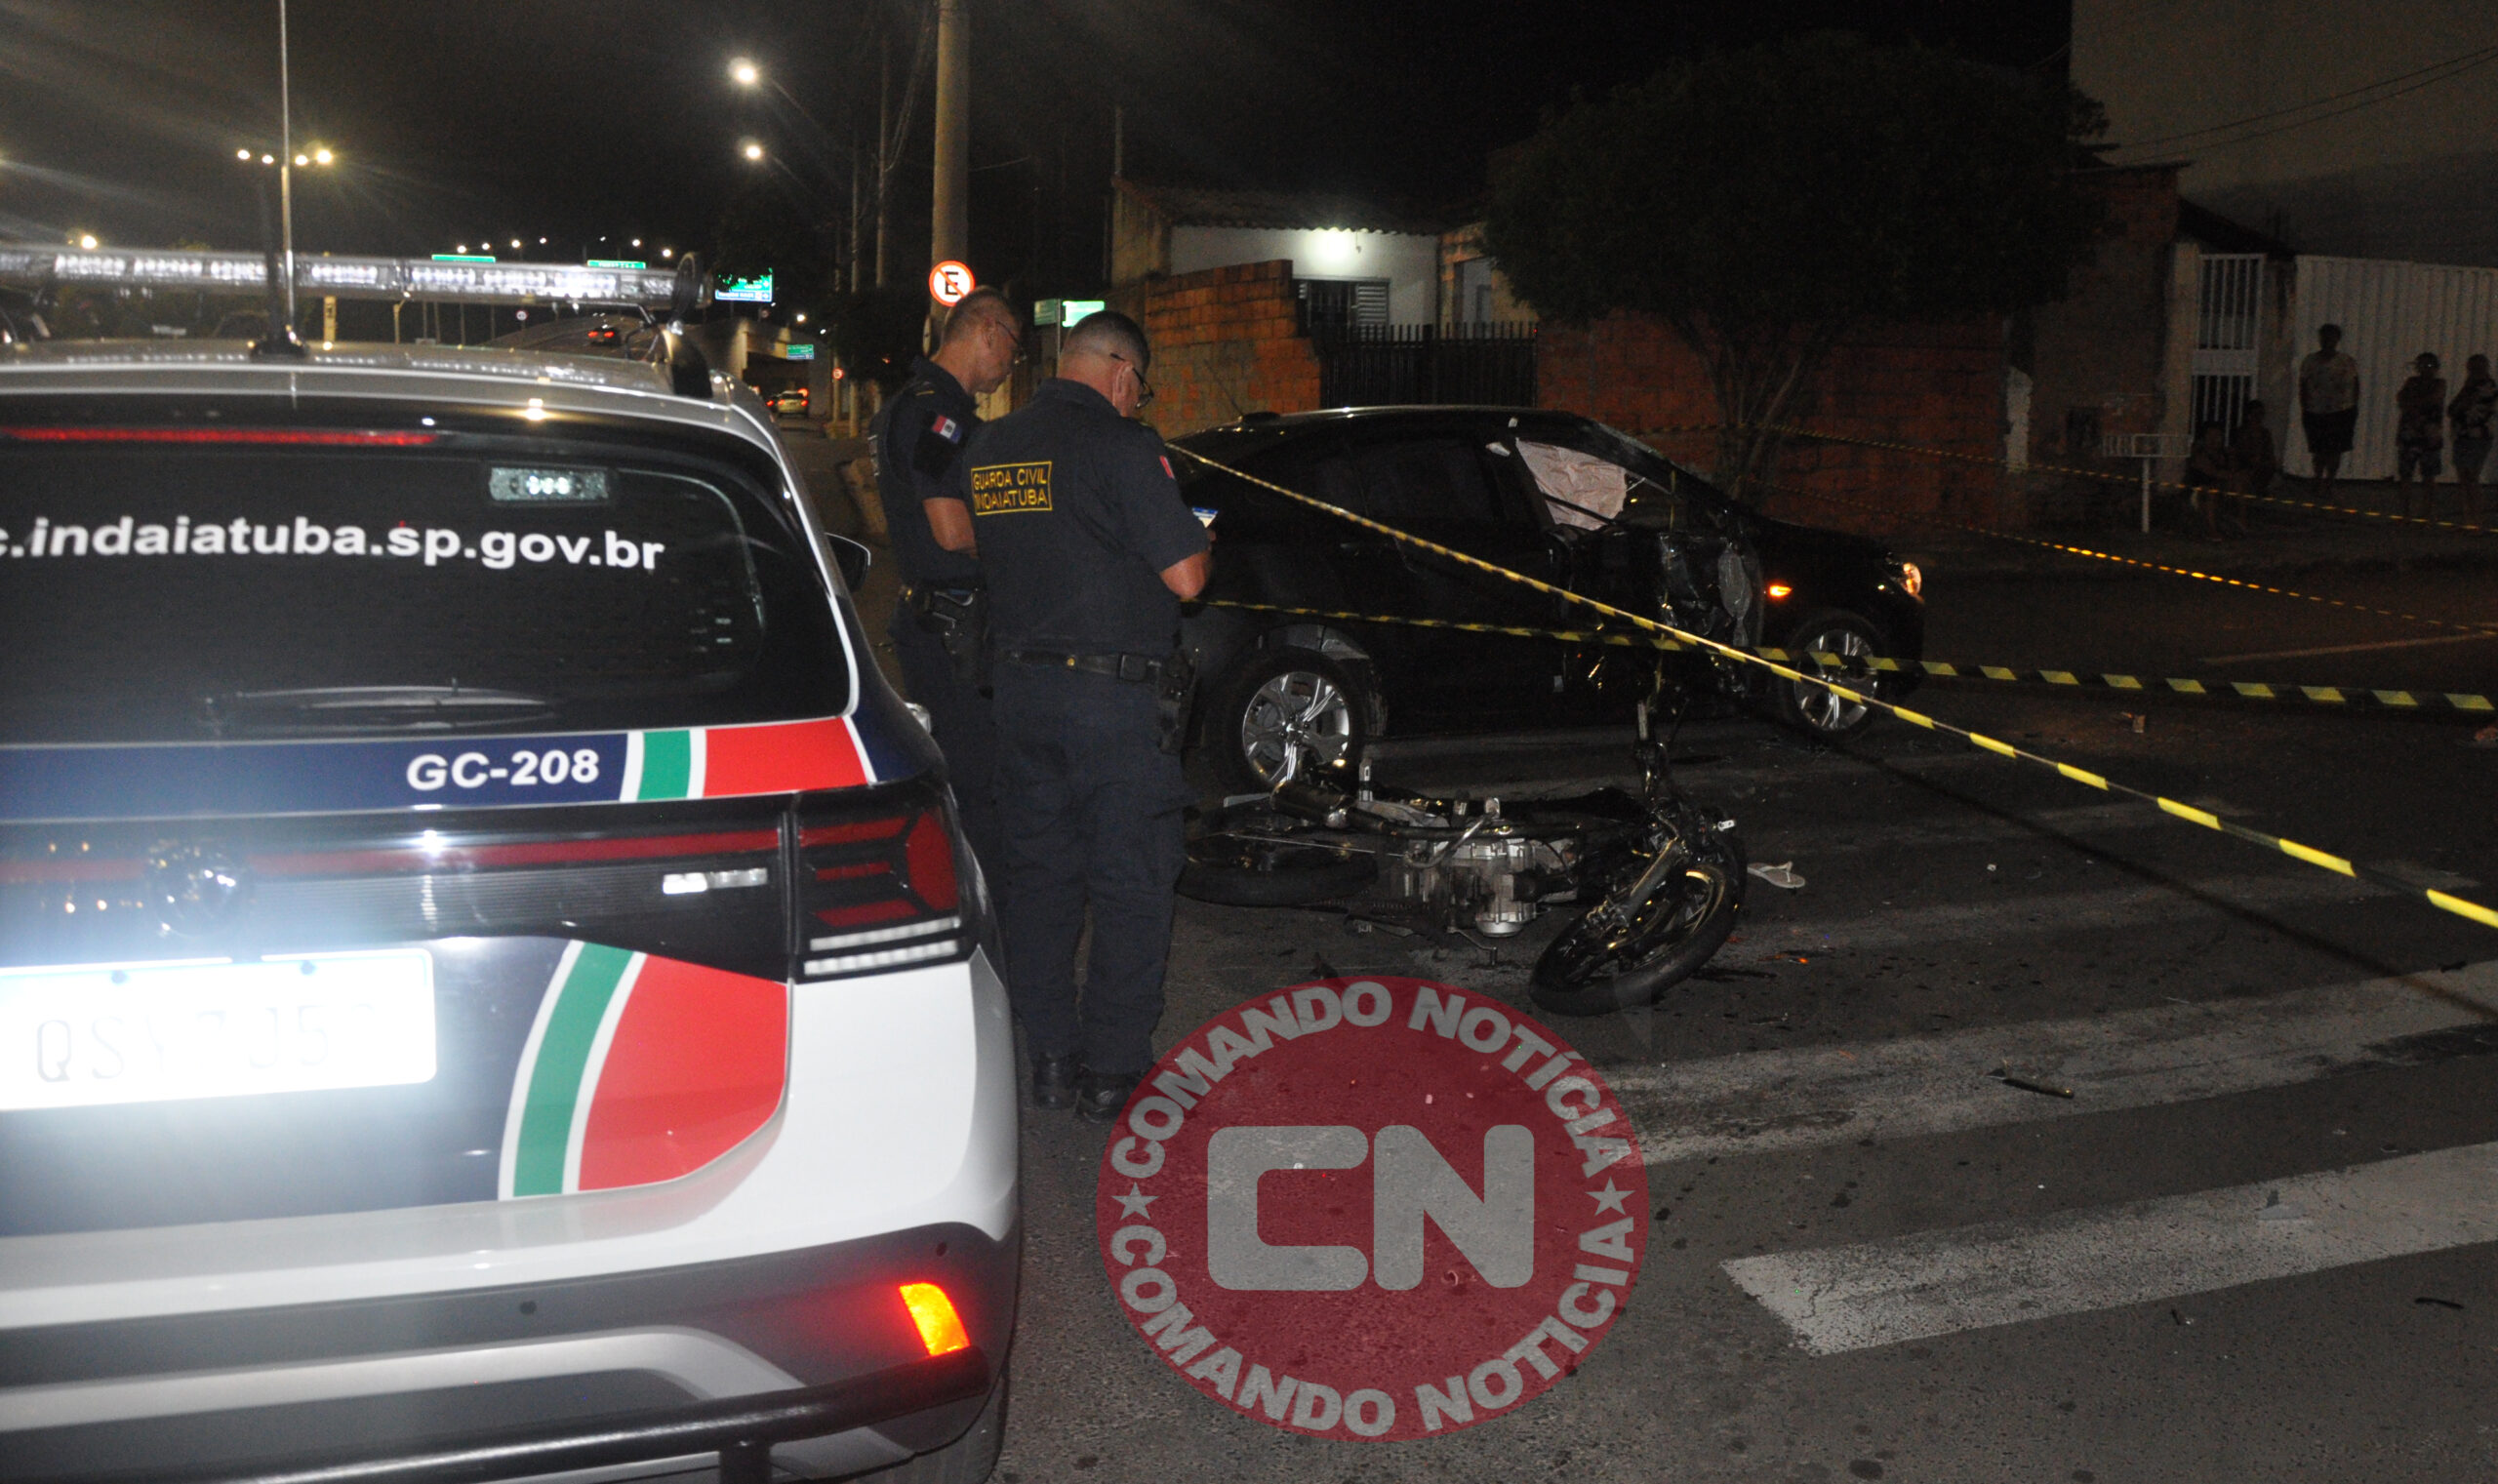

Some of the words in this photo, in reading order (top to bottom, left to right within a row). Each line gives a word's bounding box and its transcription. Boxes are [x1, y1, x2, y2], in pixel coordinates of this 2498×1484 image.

[973, 470, 1013, 491] GUARDA
[1016, 467, 1047, 486] CIVIL
[406, 748, 599, 791] GC-208
